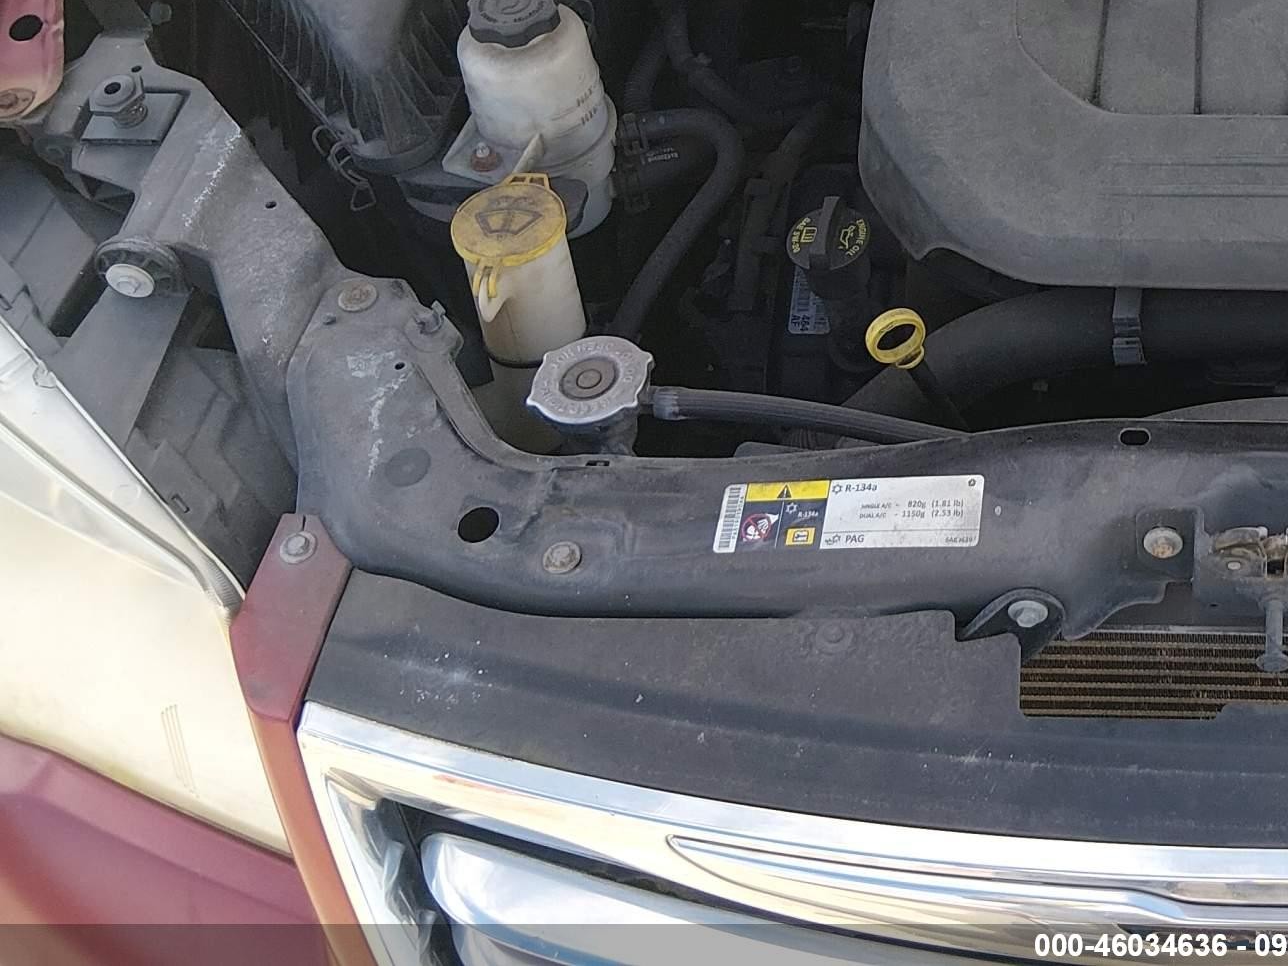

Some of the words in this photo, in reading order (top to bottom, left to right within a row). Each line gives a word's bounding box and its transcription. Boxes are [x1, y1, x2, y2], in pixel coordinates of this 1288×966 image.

[846, 245, 860, 256] OIL
[845, 483, 878, 493] R-134a
[907, 500, 927, 510] 820g
[845, 534, 865, 545] PAG
